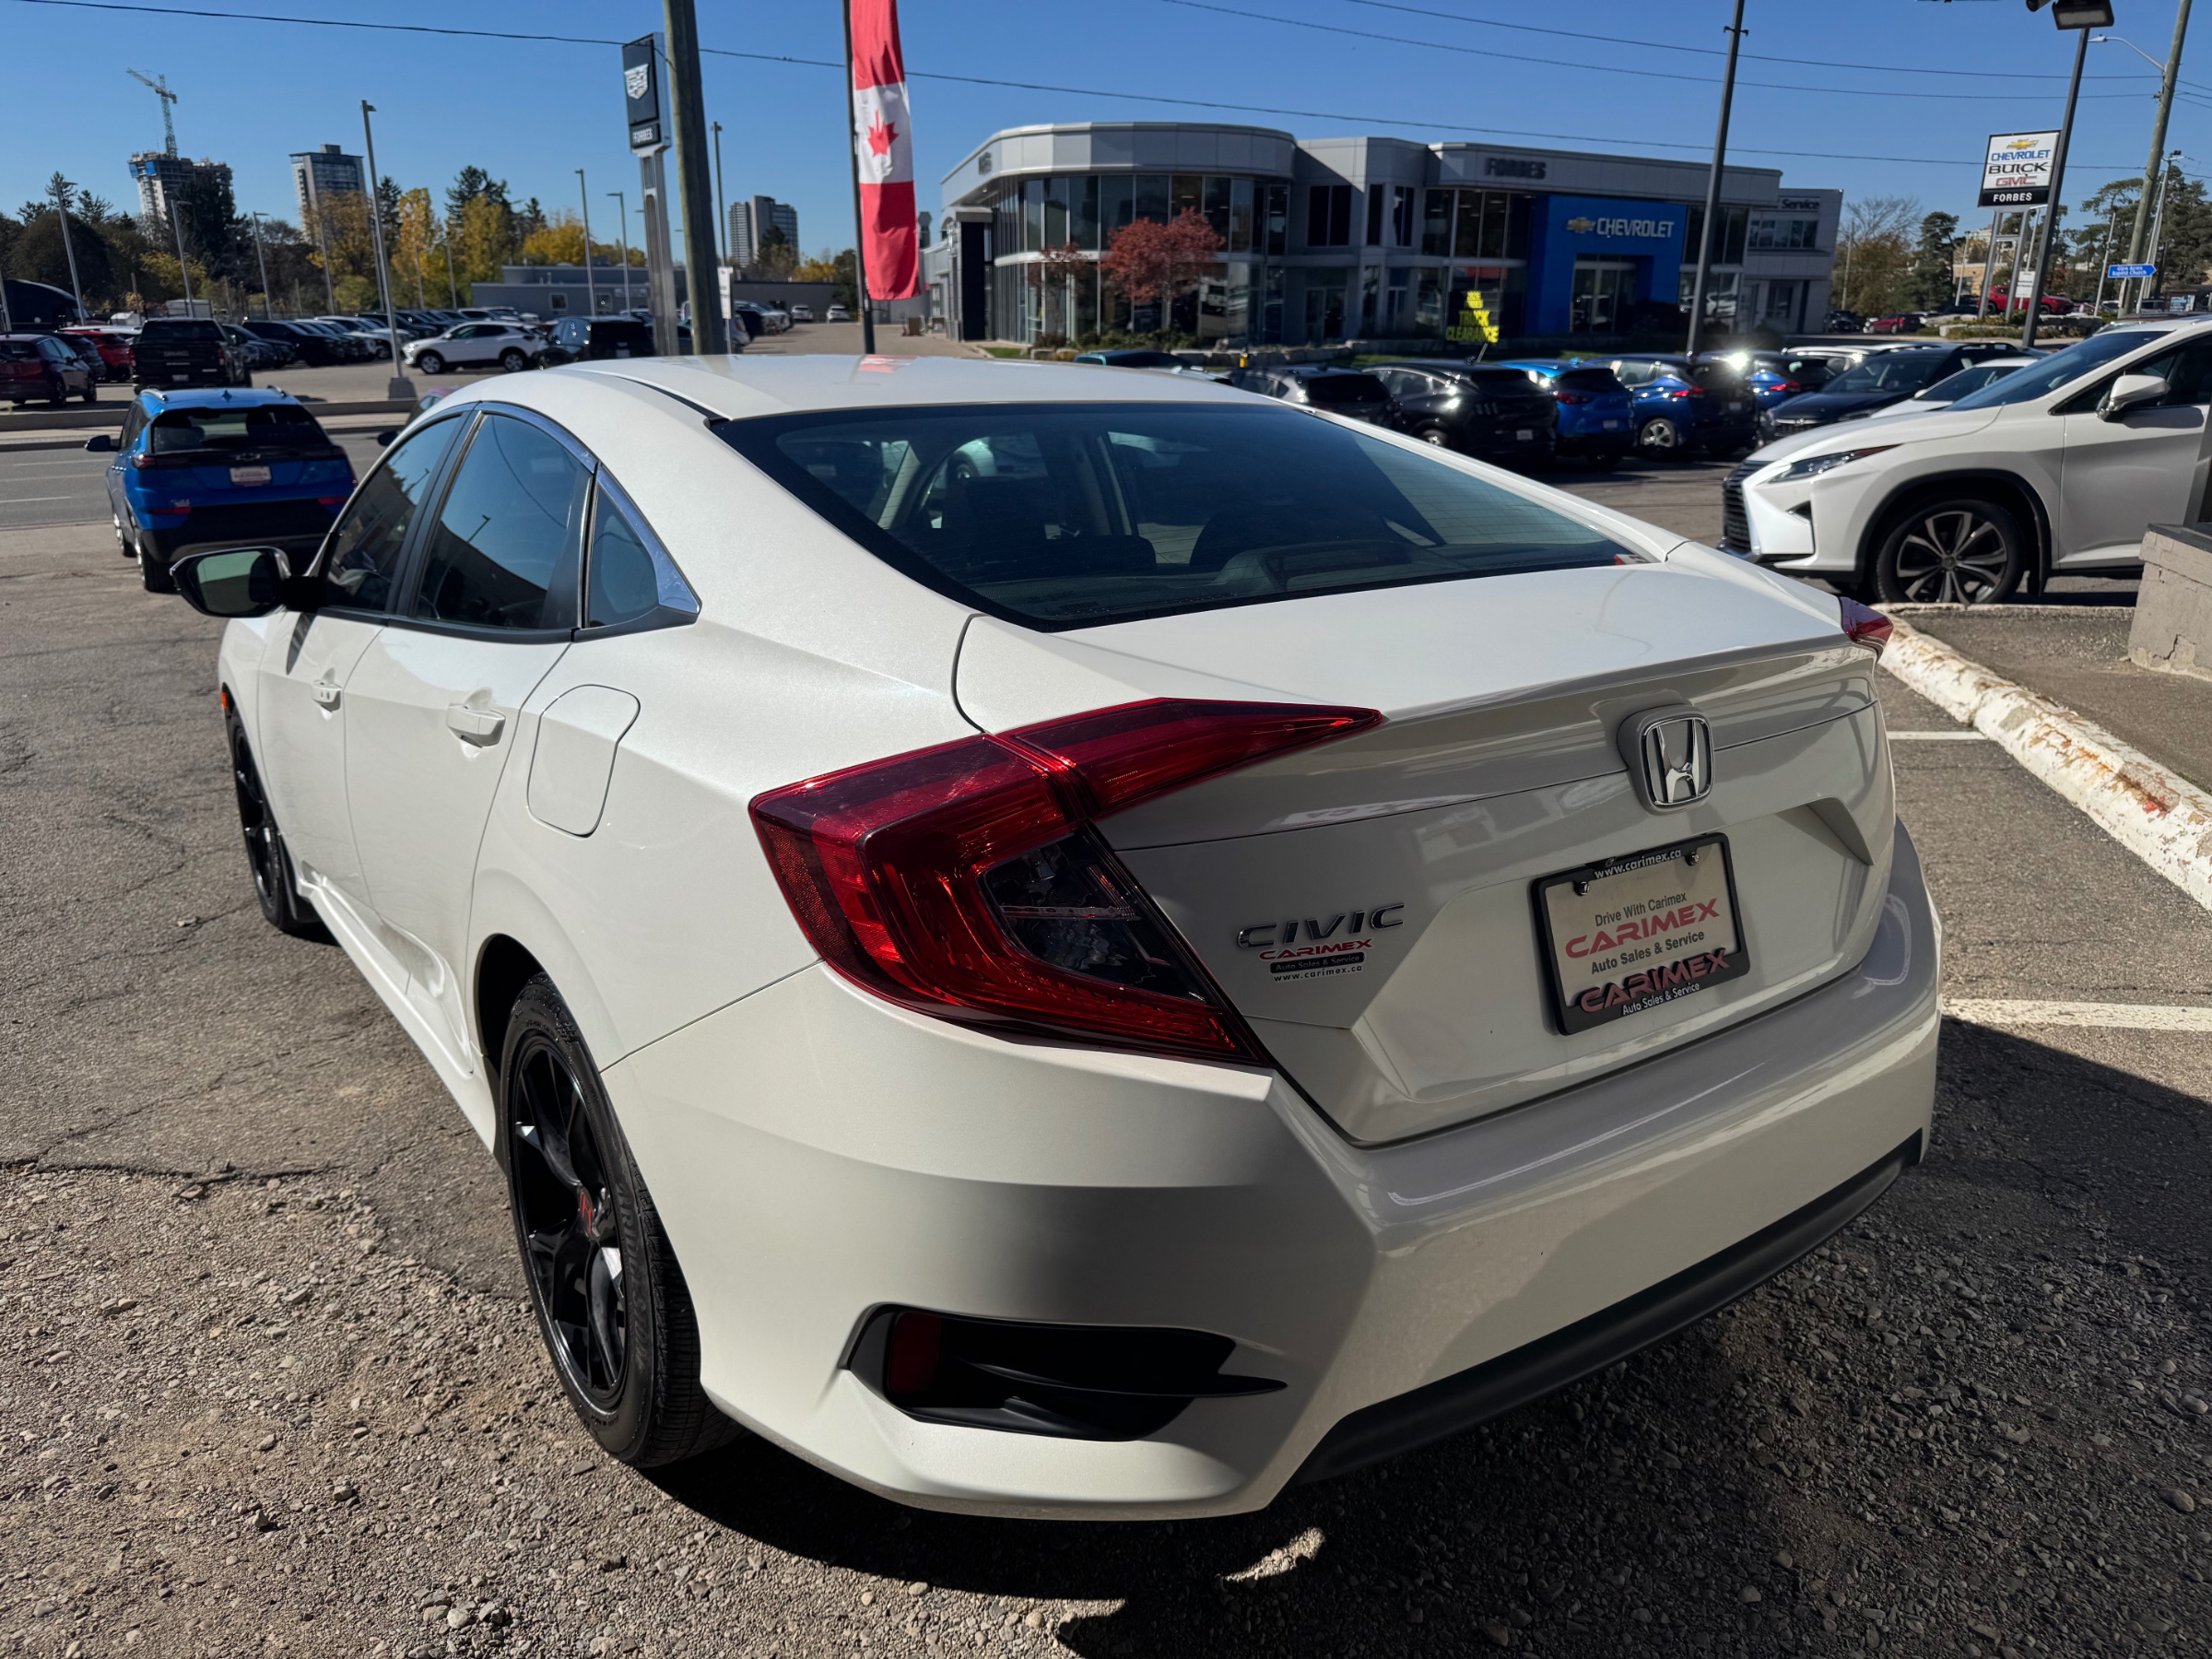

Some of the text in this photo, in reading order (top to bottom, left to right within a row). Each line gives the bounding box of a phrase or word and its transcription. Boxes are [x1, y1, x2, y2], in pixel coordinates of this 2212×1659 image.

[1991, 149, 2051, 161] CHEVROLET
[1988, 162, 2049, 175] BUICK
[1995, 175, 2037, 187] GMC
[1993, 193, 2033, 203] FORBES
[1596, 218, 1675, 238] CHEVROLET
[1594, 849, 1682, 879] www.carimex.ca
[1594, 891, 1688, 927] Drive With Carimex
[1237, 902, 1406, 948] CIVIC
[1565, 898, 1720, 959] CARIMEX
[1259, 938, 1373, 960] CARIMEX
[1591, 929, 1705, 974] Auto Sales & Service
[1274, 965, 1362, 982] www.carimex.ca
[1276, 961, 1296, 971] Auto
[1298, 959, 1321, 968] Sales
[1331, 955, 1360, 965] Service
[1579, 947, 1731, 1013] CARIMEX
[1622, 982, 1700, 1016] Auto Sales & Service
